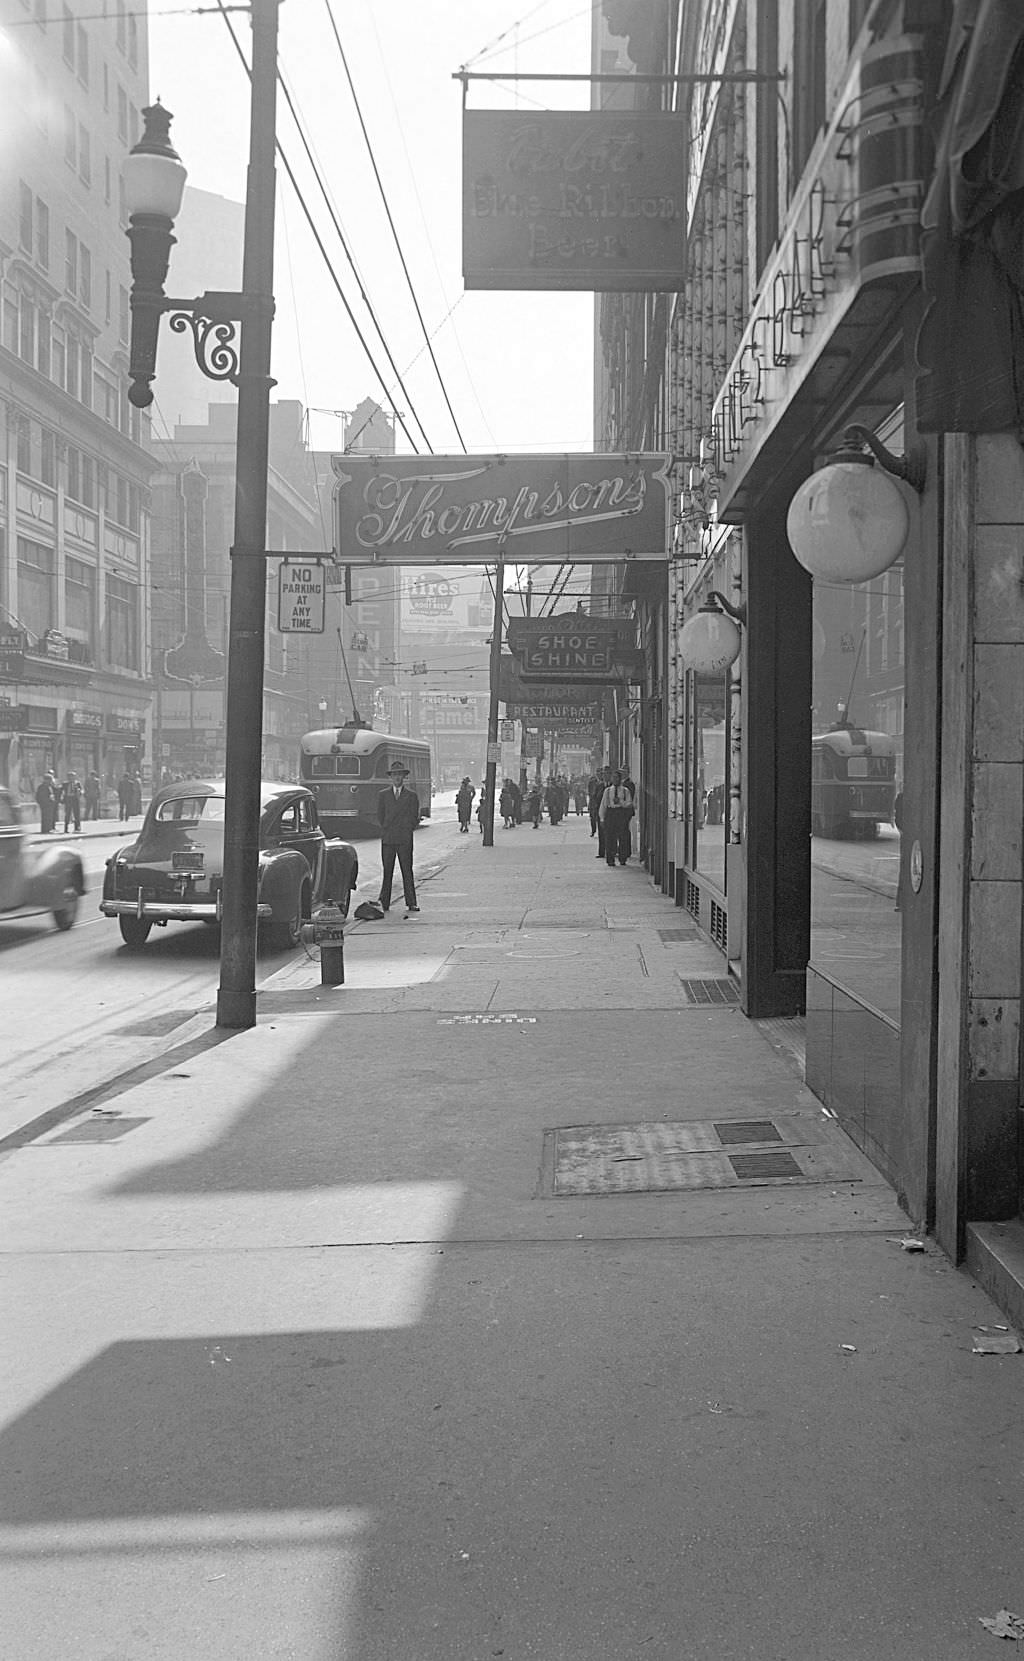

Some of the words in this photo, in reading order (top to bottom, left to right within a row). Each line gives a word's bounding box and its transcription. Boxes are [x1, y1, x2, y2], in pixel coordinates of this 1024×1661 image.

[528, 222, 619, 258] Beer
[292, 568, 312, 582] NO
[282, 584, 321, 594] PARKING
[401, 574, 460, 596] Hires
[296, 595, 308, 605] AT
[292, 607, 311, 616] ANY
[292, 618, 312, 628] TIME
[538, 636, 598, 650] SHOE
[530, 652, 606, 666] SHINE
[513, 705, 595, 718] RESTAURANT
